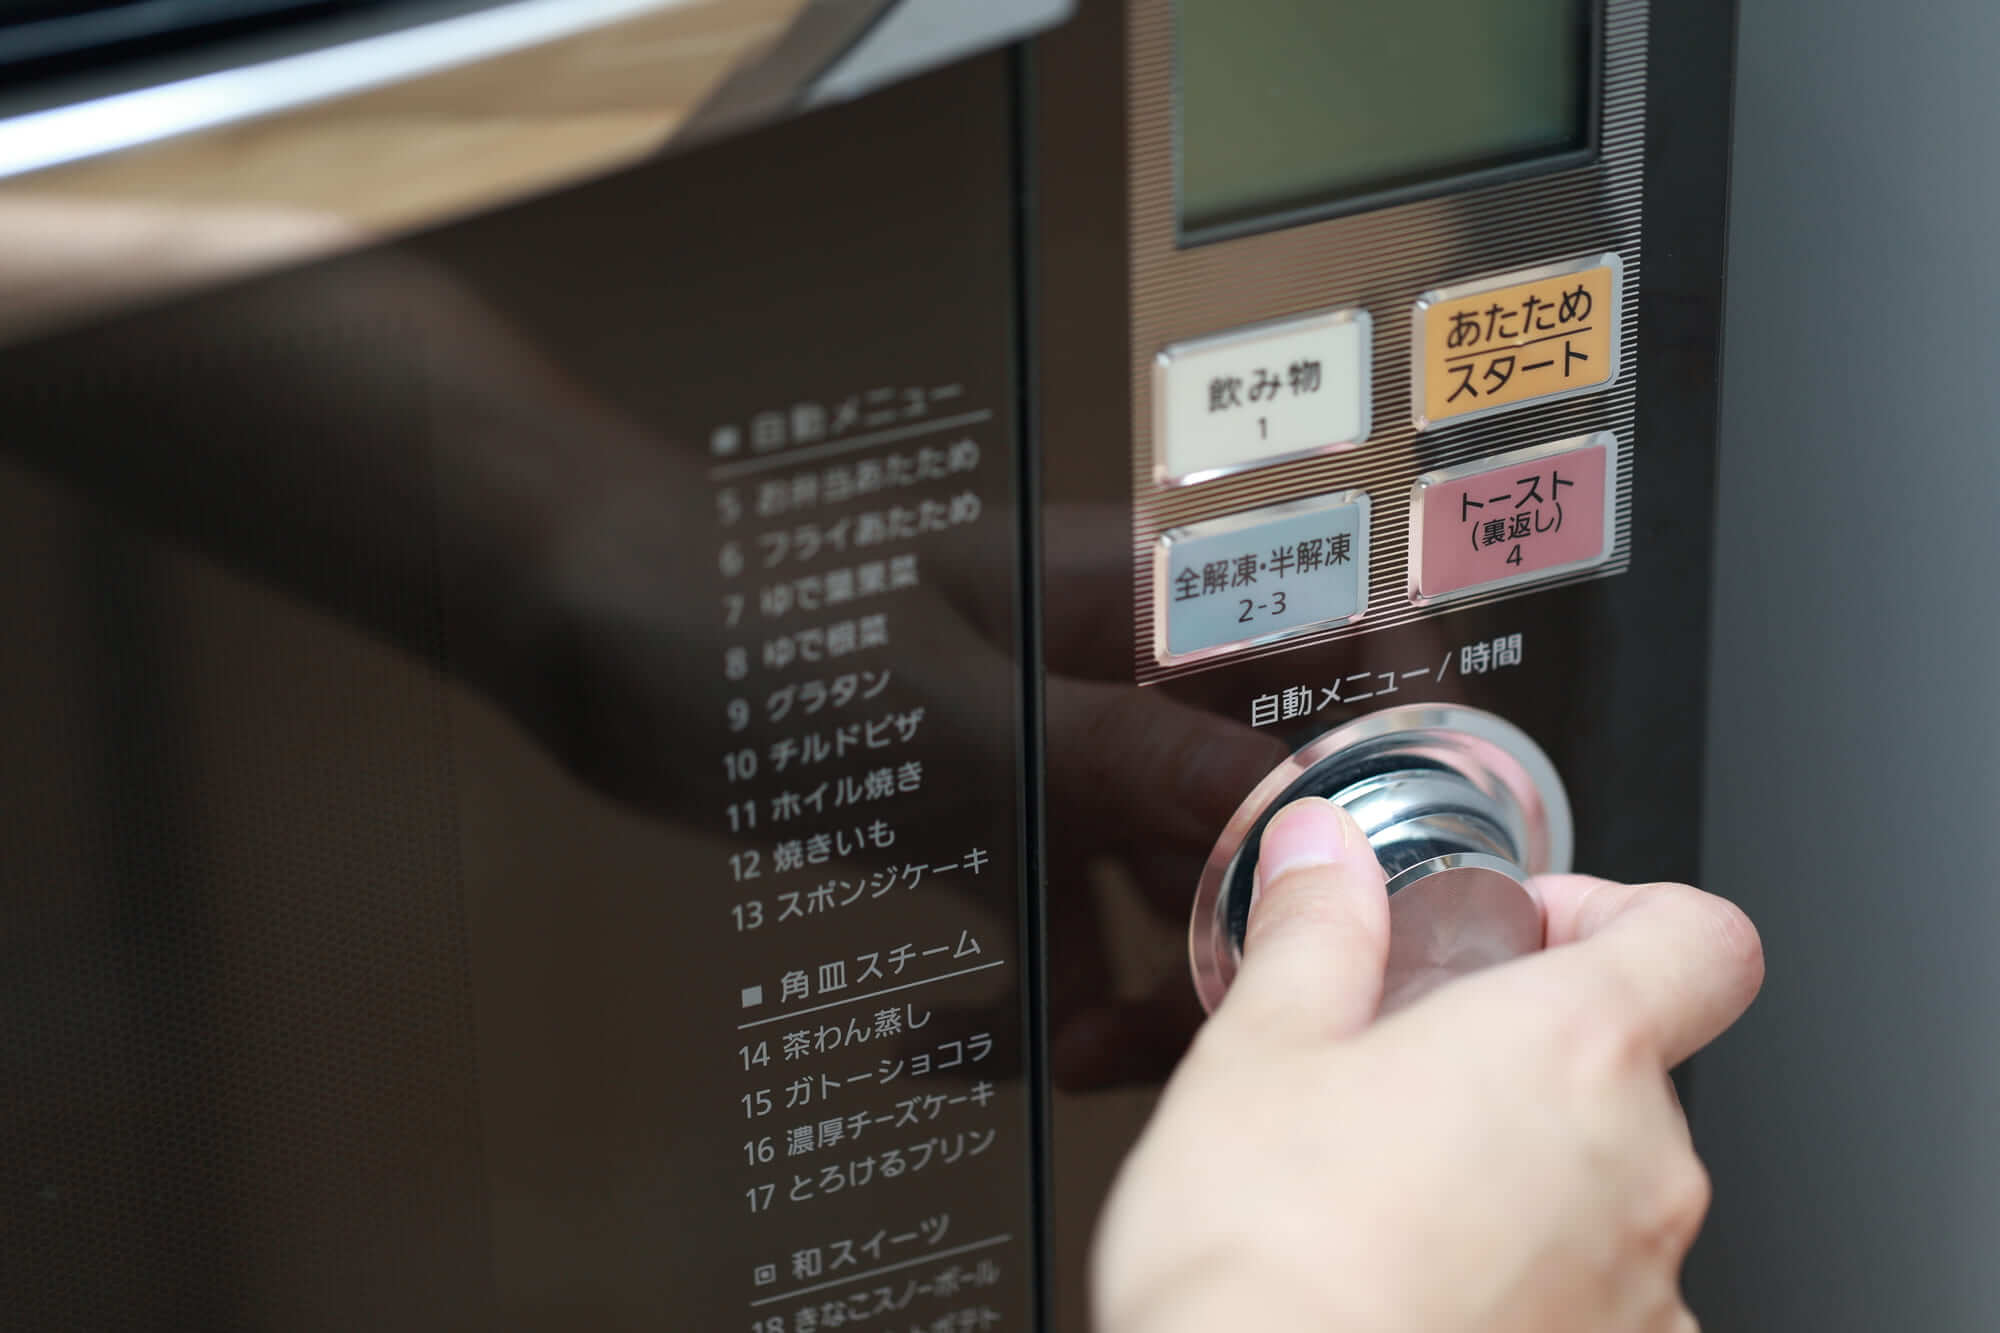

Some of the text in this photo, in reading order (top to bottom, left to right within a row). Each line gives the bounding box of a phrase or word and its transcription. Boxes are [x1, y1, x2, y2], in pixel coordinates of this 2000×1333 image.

[1446, 283, 1594, 350] あたため
[1208, 358, 1323, 414] 飲み物
[1446, 339, 1589, 404] スタート
[1258, 417, 1269, 441] 1
[1461, 470, 1575, 523] トースト
[1470, 502, 1564, 553] (裏返し)
[1173, 532, 1353, 604] 全解凍・半解凍
[1505, 543, 1524, 567] 4
[724, 594, 744, 628] 7
[1237, 590, 1288, 625] 2-3
[725, 646, 748, 681] 8
[727, 669, 891, 732] 9 グラタン
[723, 749, 758, 783] 10
[725, 761, 924, 832] 11 ホイル焼き
[729, 819, 896, 882] 12 焼きいも
[731, 847, 990, 932] 13 スポンジケーキ
[780, 929, 982, 1004] 角皿スチーム
[738, 1002, 932, 1071] 14 茶わん蒸し
[741, 1032, 994, 1119] 15 ガトーショコラ
[743, 1081, 996, 1167] 16 濃厚チーズケーキ
[745, 1129, 996, 1213] 17 とろけるプリン
[791, 1213, 951, 1281] 和スイーツ
